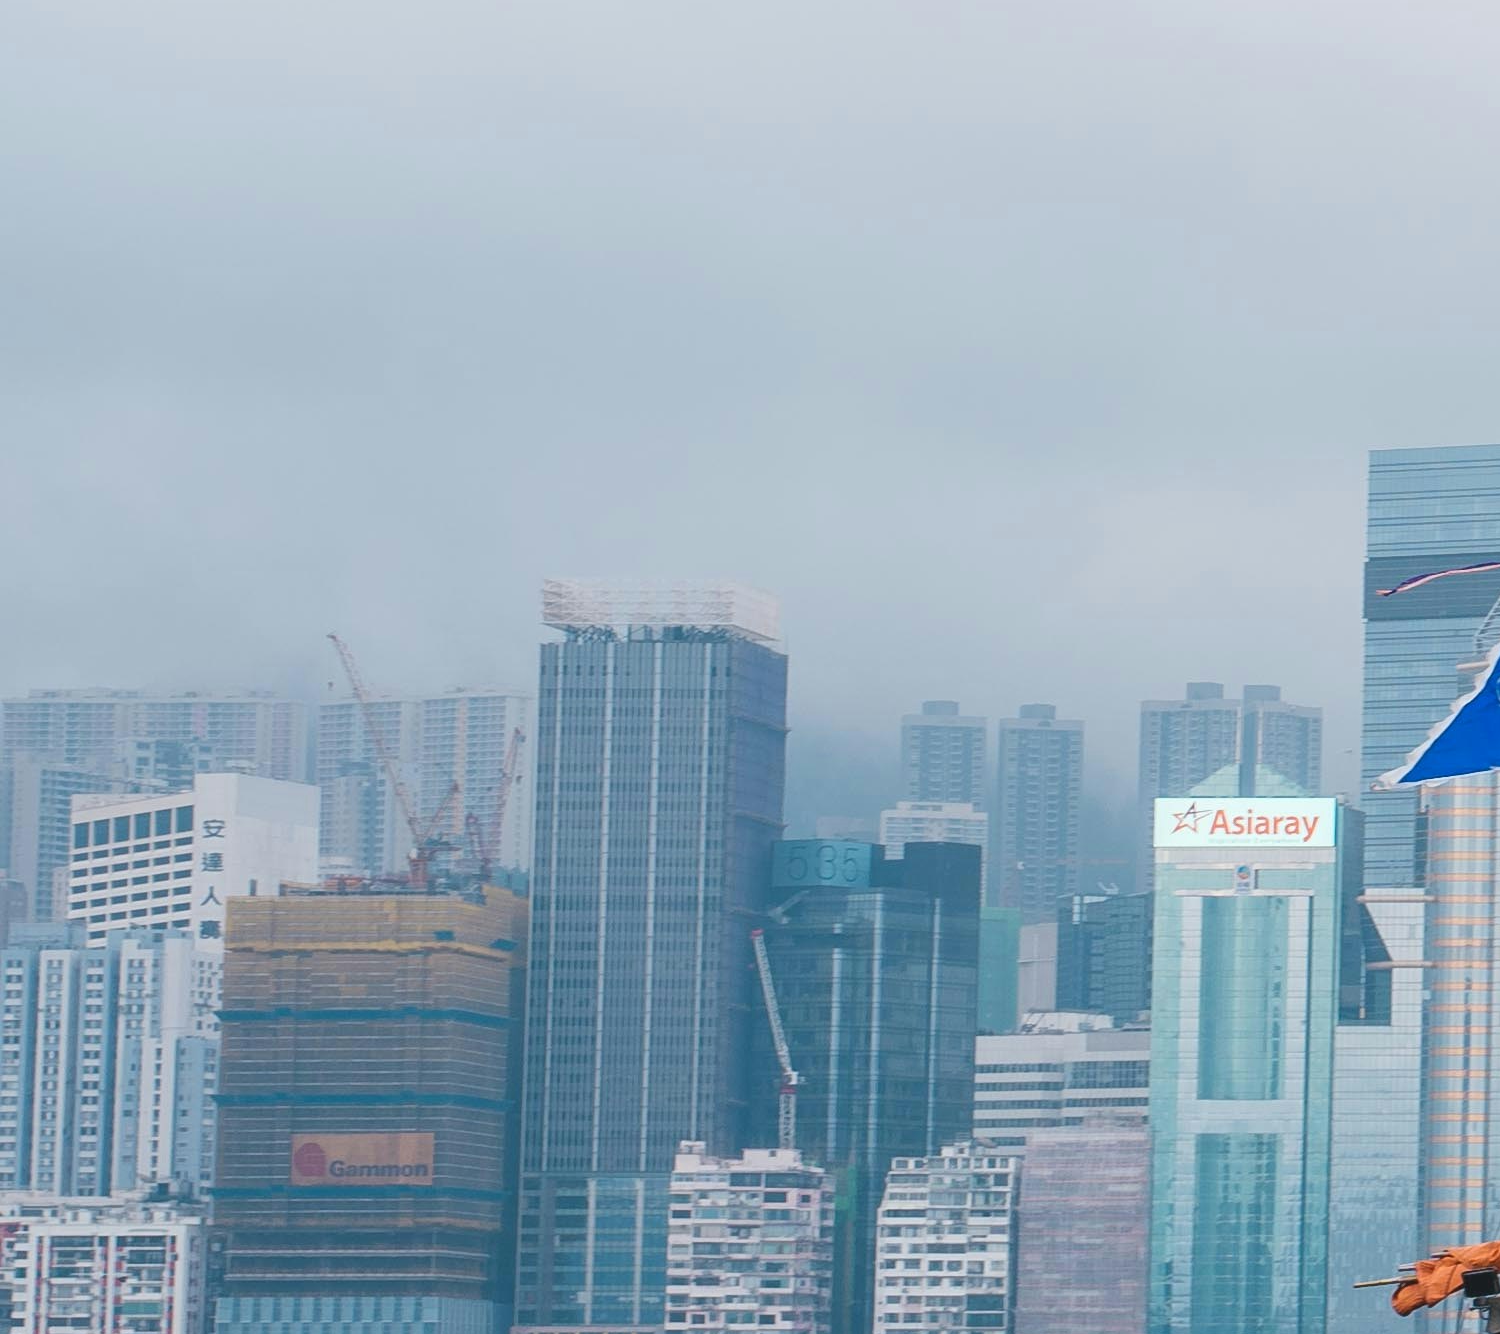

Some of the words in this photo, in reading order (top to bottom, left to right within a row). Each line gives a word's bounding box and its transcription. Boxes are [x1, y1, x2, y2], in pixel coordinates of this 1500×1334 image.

[1209, 809, 1320, 843] Asiaray
[786, 845, 859, 882] 535
[329, 1160, 429, 1178] Gammon
